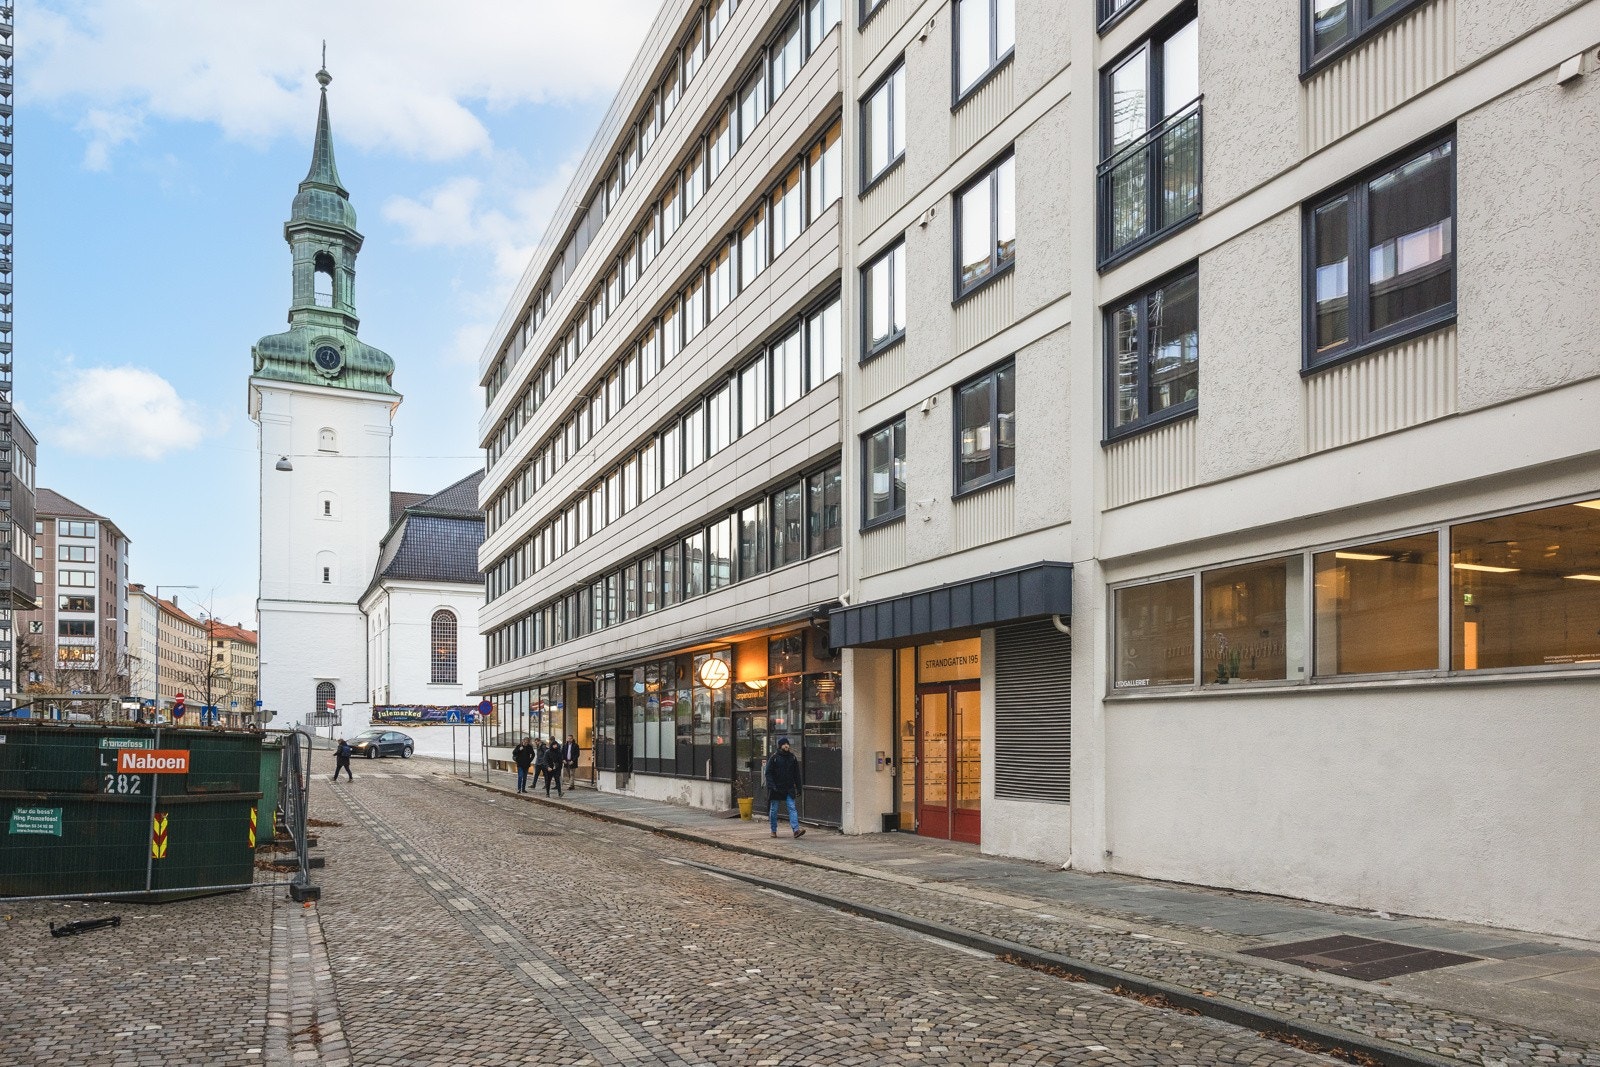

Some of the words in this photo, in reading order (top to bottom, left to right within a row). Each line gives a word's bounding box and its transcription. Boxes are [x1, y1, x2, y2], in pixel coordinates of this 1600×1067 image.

[925, 656, 967, 669] STRANDGATEN
[968, 655, 979, 664] 195
[1115, 678, 1150, 688] LYDGALLERIET
[378, 710, 422, 718] Julemarked
[102, 739, 143, 748] Franzefoss
[122, 753, 186, 769] Naboen
[103, 774, 141, 794] 282
